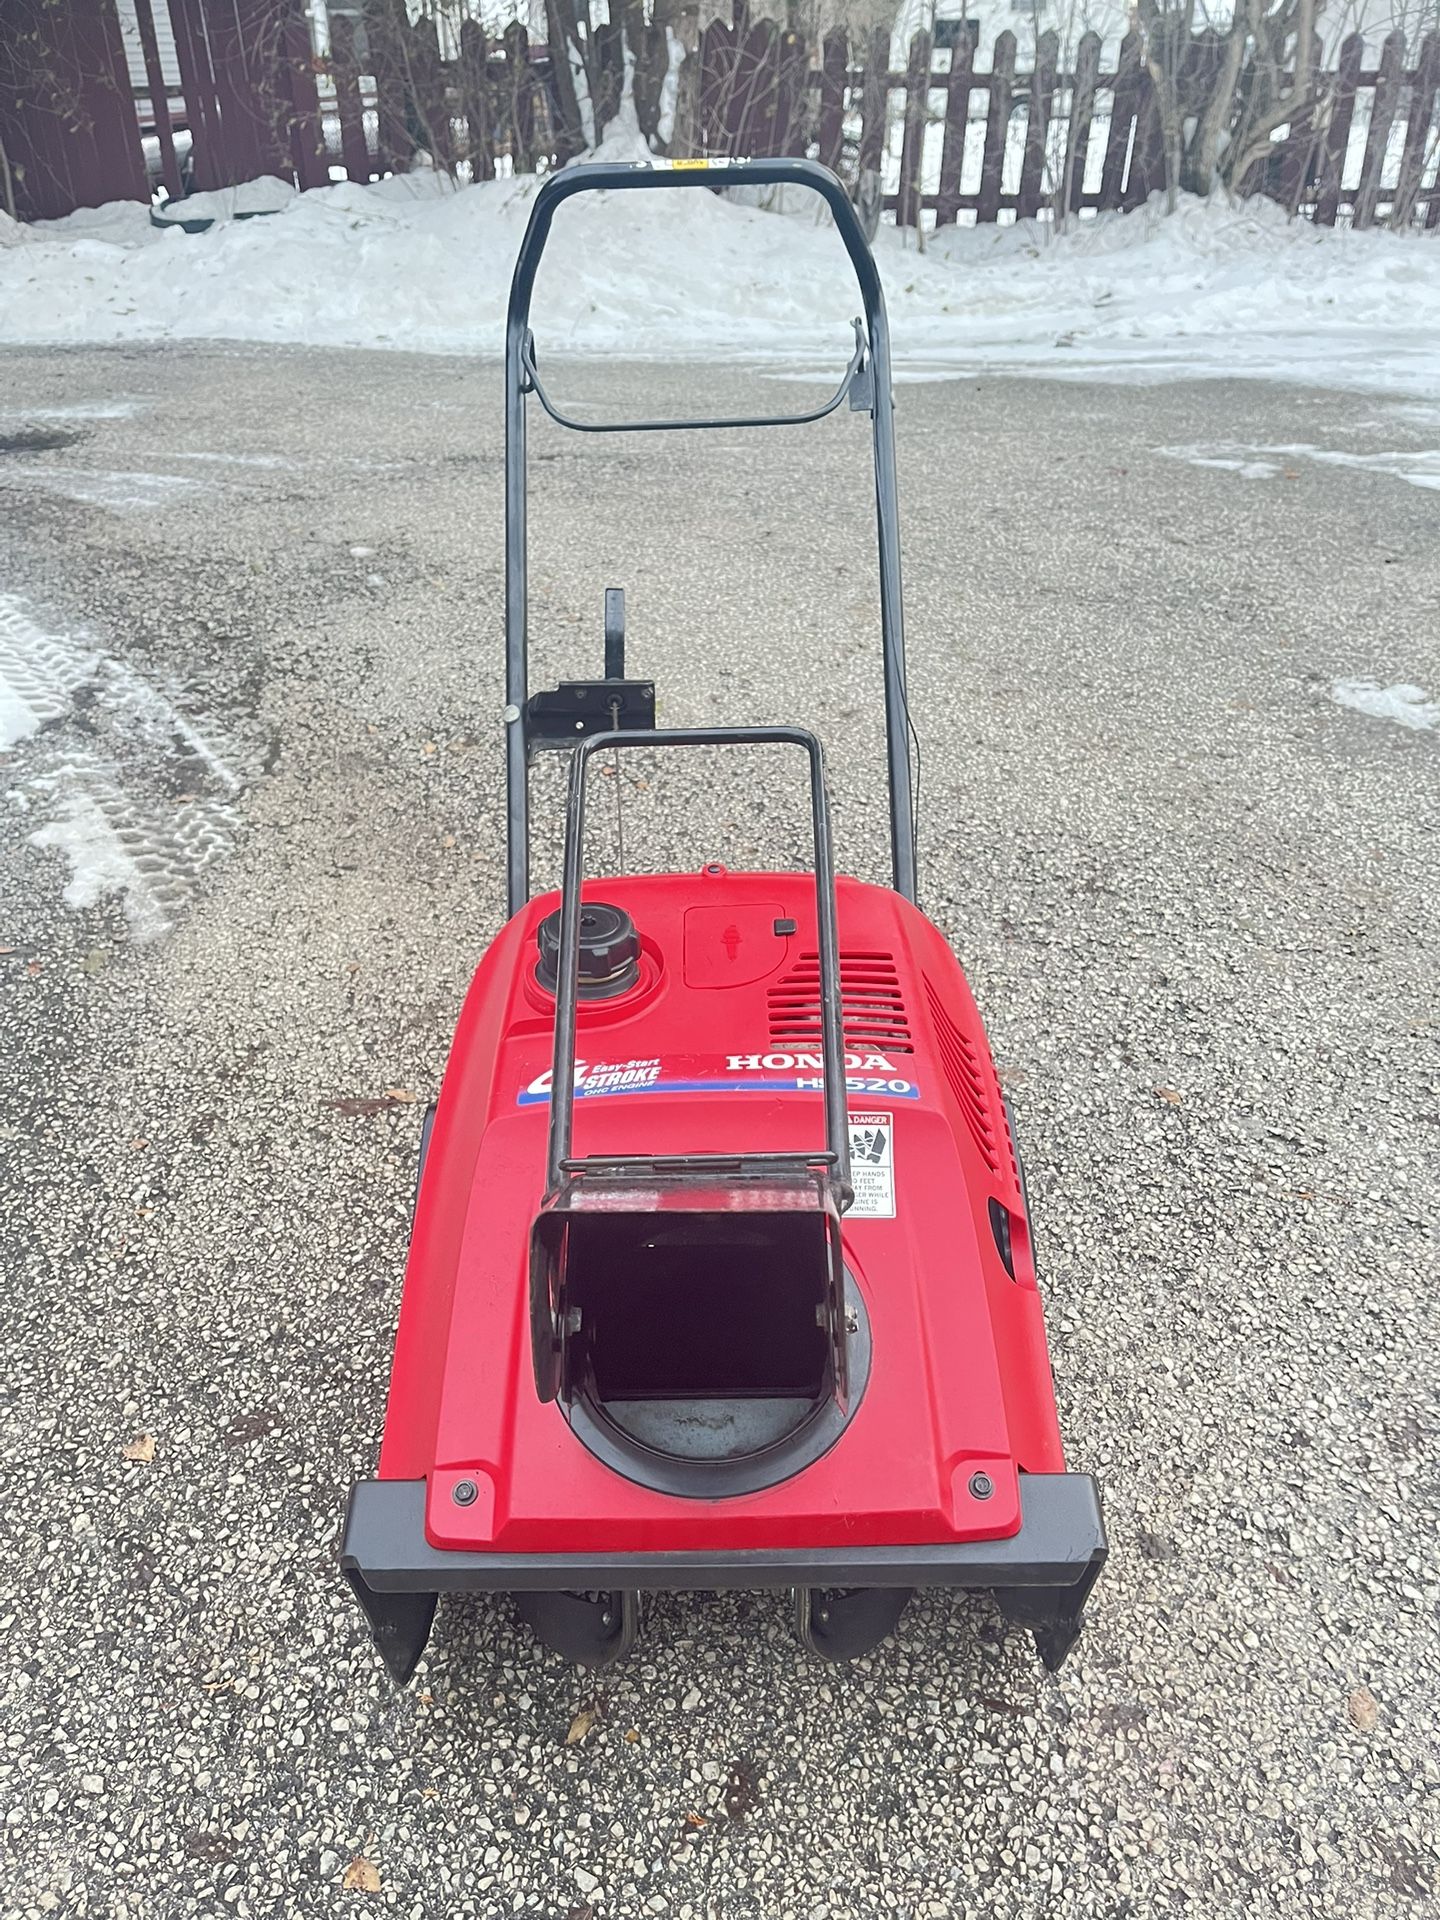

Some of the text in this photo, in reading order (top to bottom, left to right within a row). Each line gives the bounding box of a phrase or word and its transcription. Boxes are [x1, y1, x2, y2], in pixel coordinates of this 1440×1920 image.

[592, 1058, 661, 1074] Easy-Start
[583, 1066, 663, 1090] STROKE
[584, 1080, 656, 1096] OHC ENGINE
[853, 1115, 887, 1124] DANGER
